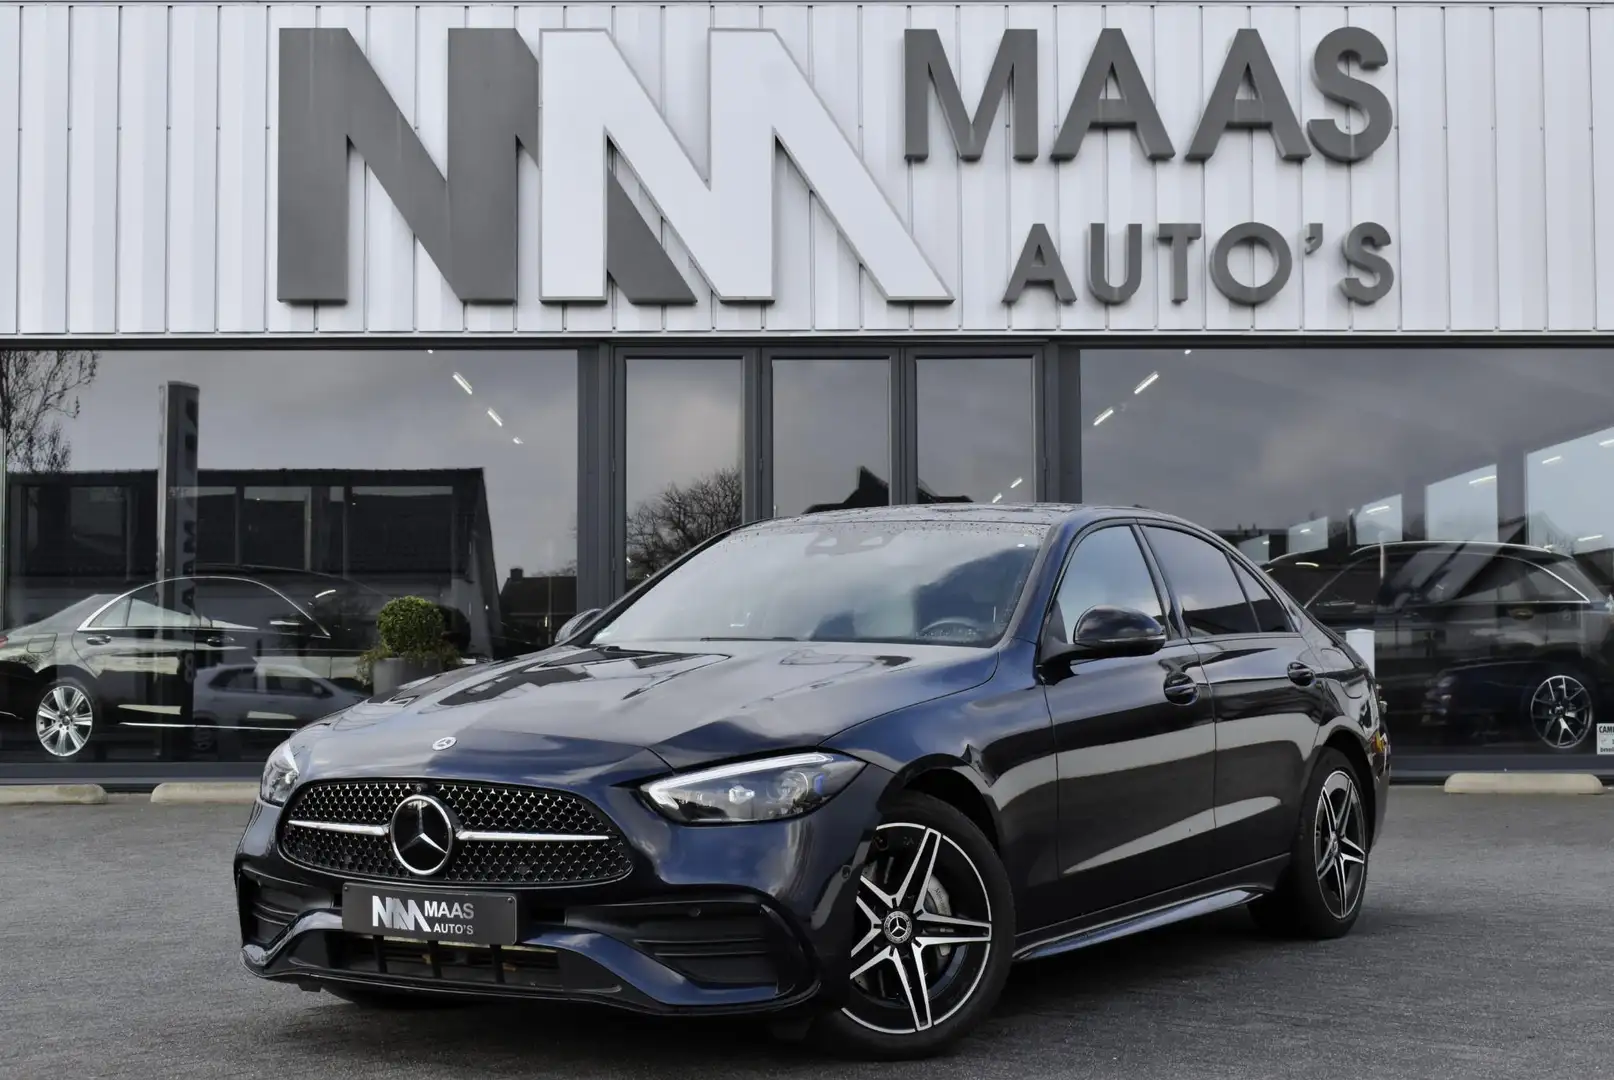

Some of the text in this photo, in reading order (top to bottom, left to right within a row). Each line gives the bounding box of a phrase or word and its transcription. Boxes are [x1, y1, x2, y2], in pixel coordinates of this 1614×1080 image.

[904, 26, 1394, 162] MAAS
[1002, 221, 1395, 305] AUTO'S
[424, 900, 474, 919] MAAS
[433, 922, 474, 935] AUTO'S
